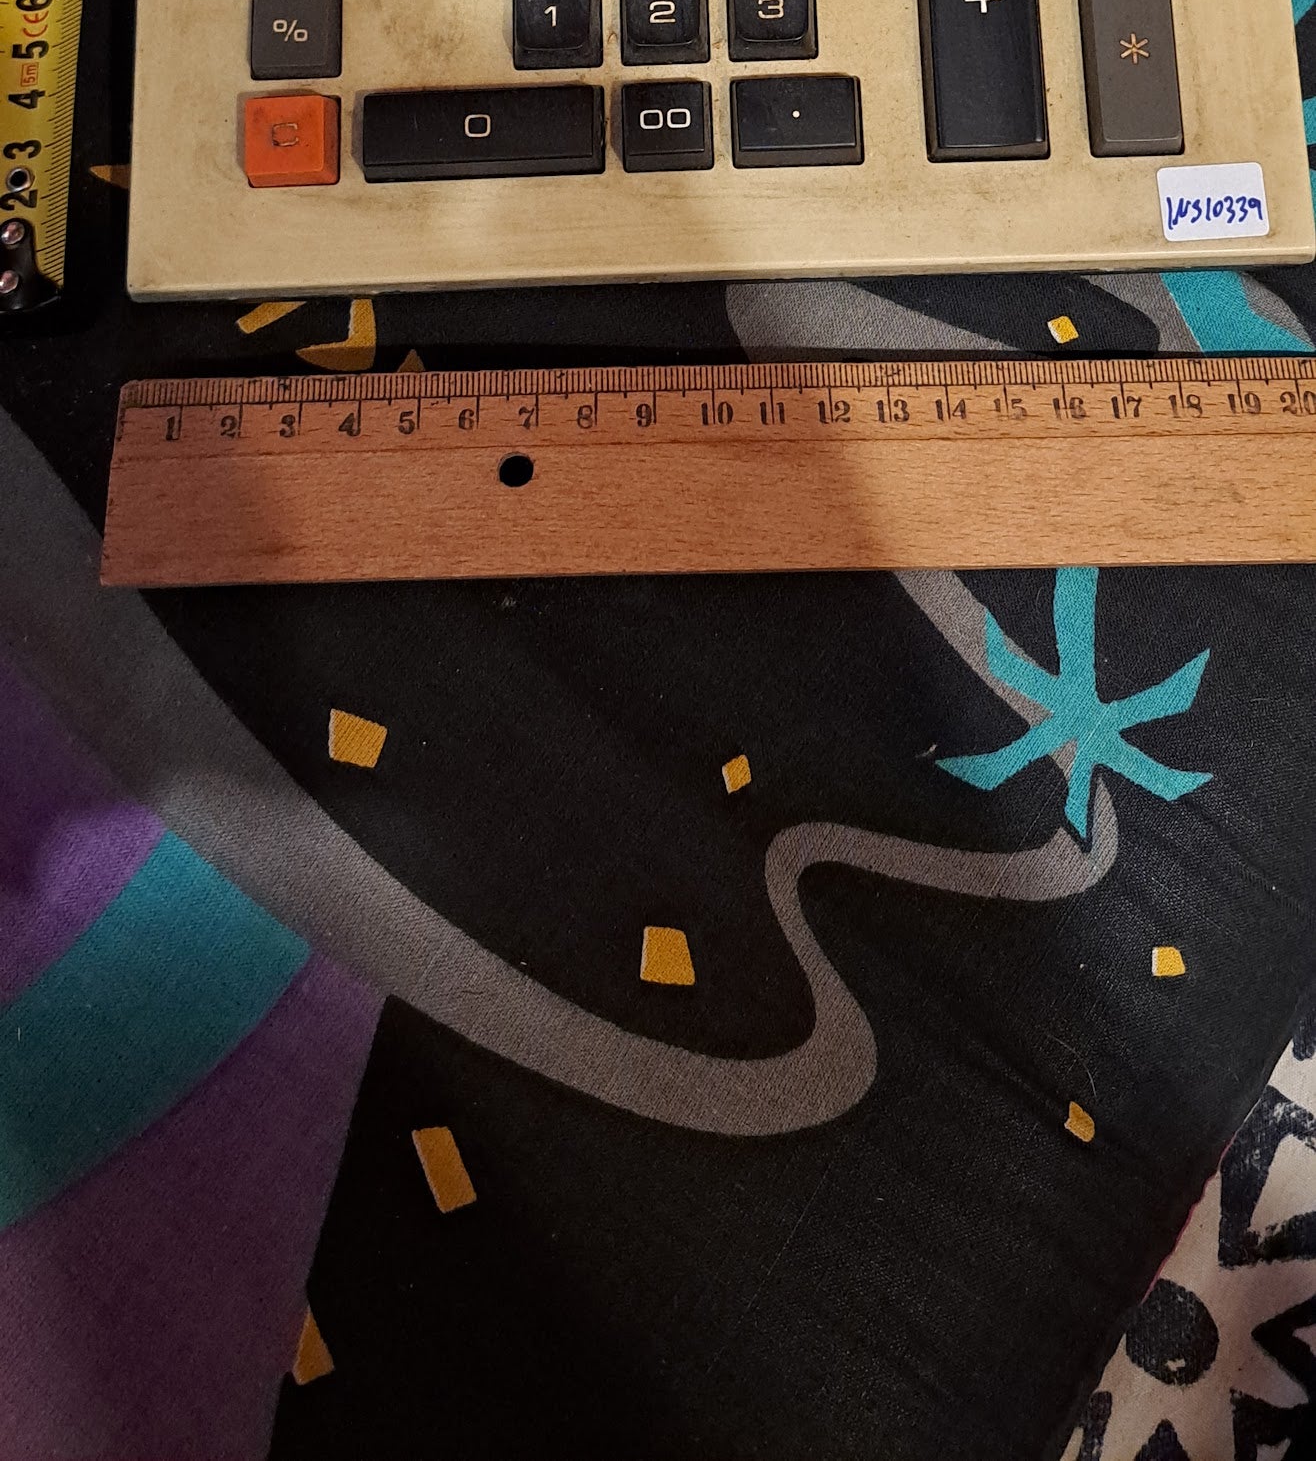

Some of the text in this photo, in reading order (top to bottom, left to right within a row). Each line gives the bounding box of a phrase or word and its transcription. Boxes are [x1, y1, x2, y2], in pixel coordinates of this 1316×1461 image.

[544, 5, 558, 27] 1
[649, 0, 676, 23] 2
[273, 19, 308, 42] %
[12, 39, 49, 60] 5
[23, 64, 38, 85] 5m
[8, 89, 46, 110] 4
[3, 140, 42, 159] 3
[0, 189, 38, 211] 2
[166, 390, 1316, 440] 1 2 3 4 5 6 7 8 9 10 11 12 13 14 15 16 17 18 19 20
